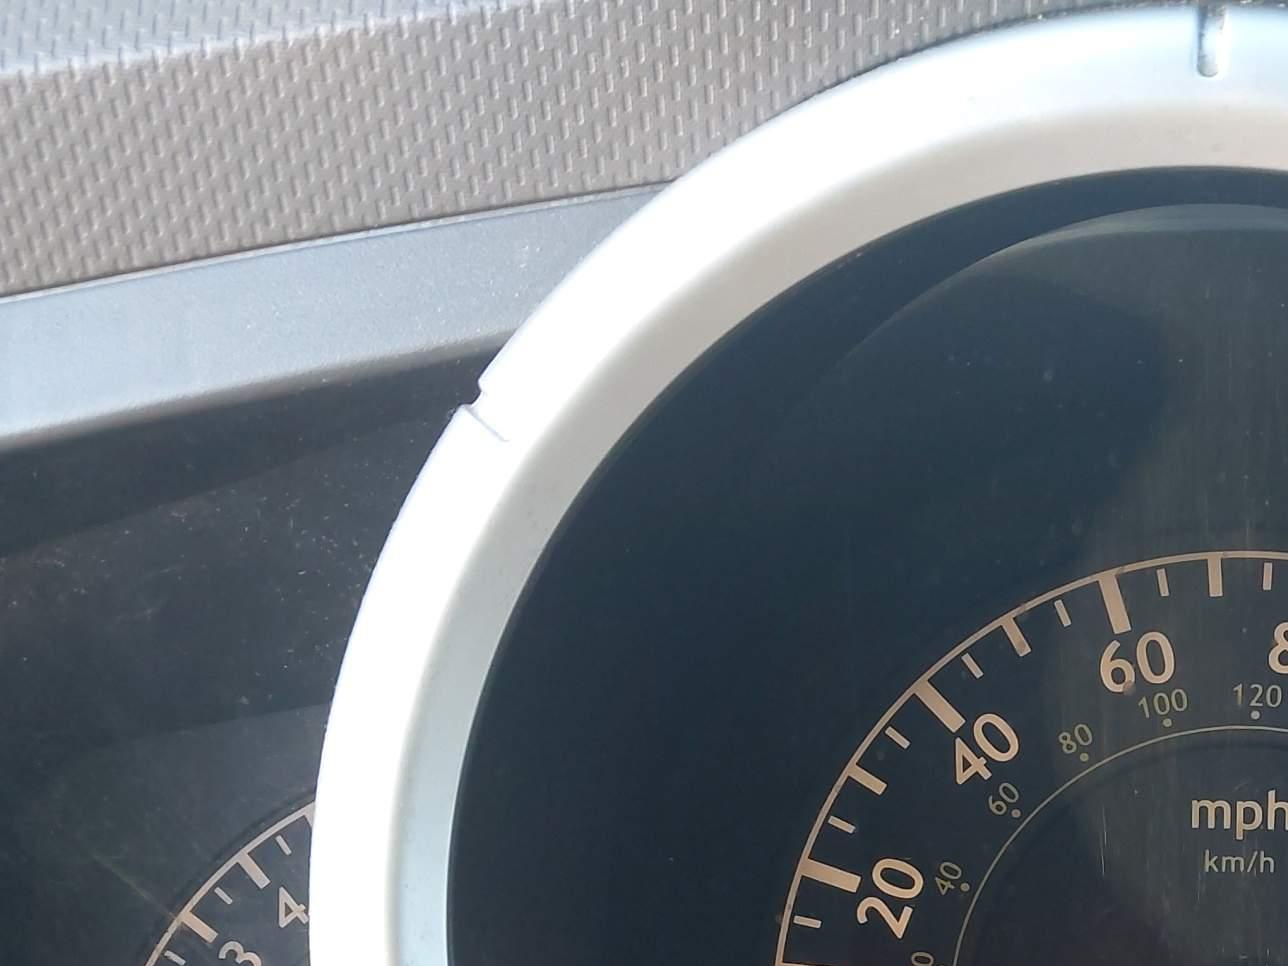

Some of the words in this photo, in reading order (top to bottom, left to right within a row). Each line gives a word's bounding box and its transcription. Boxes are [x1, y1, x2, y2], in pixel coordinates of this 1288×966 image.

[1099, 631, 1177, 693] 60
[1138, 688, 1189, 720] 100
[1231, 682, 1283, 708] 120
[953, 712, 1020, 786] 40
[1058, 722, 1094, 755] 80
[987, 782, 1020, 817] 60
[934, 861, 964, 897] 40
[1203, 848, 1276, 876] km/h
[277, 886, 309, 929] 4
[856, 857, 925, 940] 20
